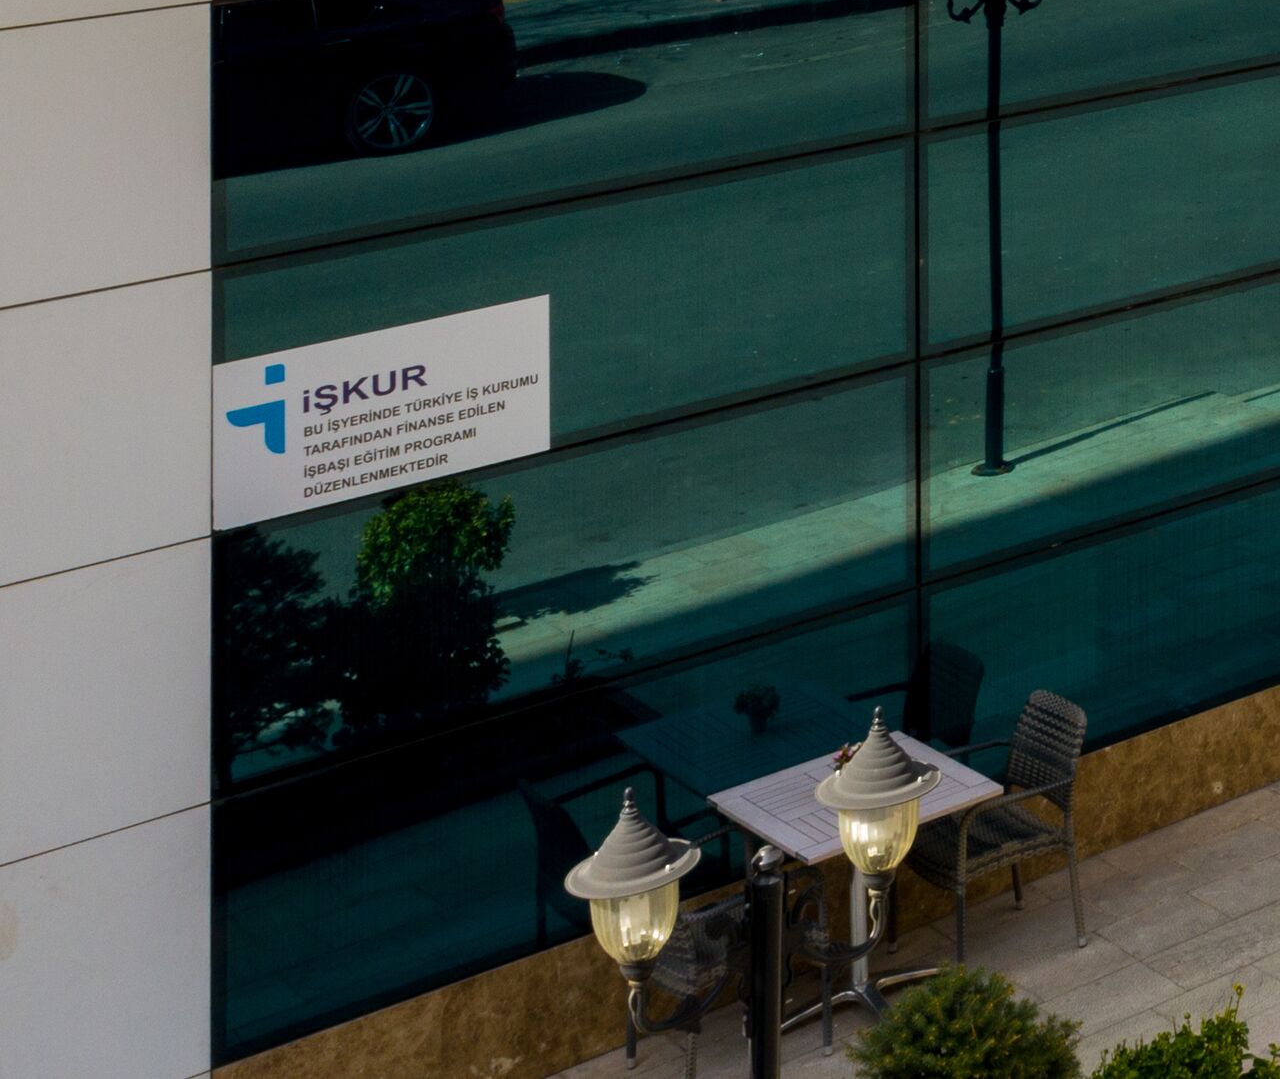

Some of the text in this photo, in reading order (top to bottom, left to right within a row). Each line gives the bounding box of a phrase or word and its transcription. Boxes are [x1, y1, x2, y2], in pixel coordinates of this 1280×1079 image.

[303, 373, 540, 438] BU İŞYERİNDE TÜRKİYE İŞ KURUMU
[303, 399, 506, 457] TARAFINDAN FİNANSE EDİLEN
[303, 427, 478, 479] İŞBAŞI EĞİTİM PROGRAMI
[303, 452, 449, 499] DÜZENLENMEKTEDİR
